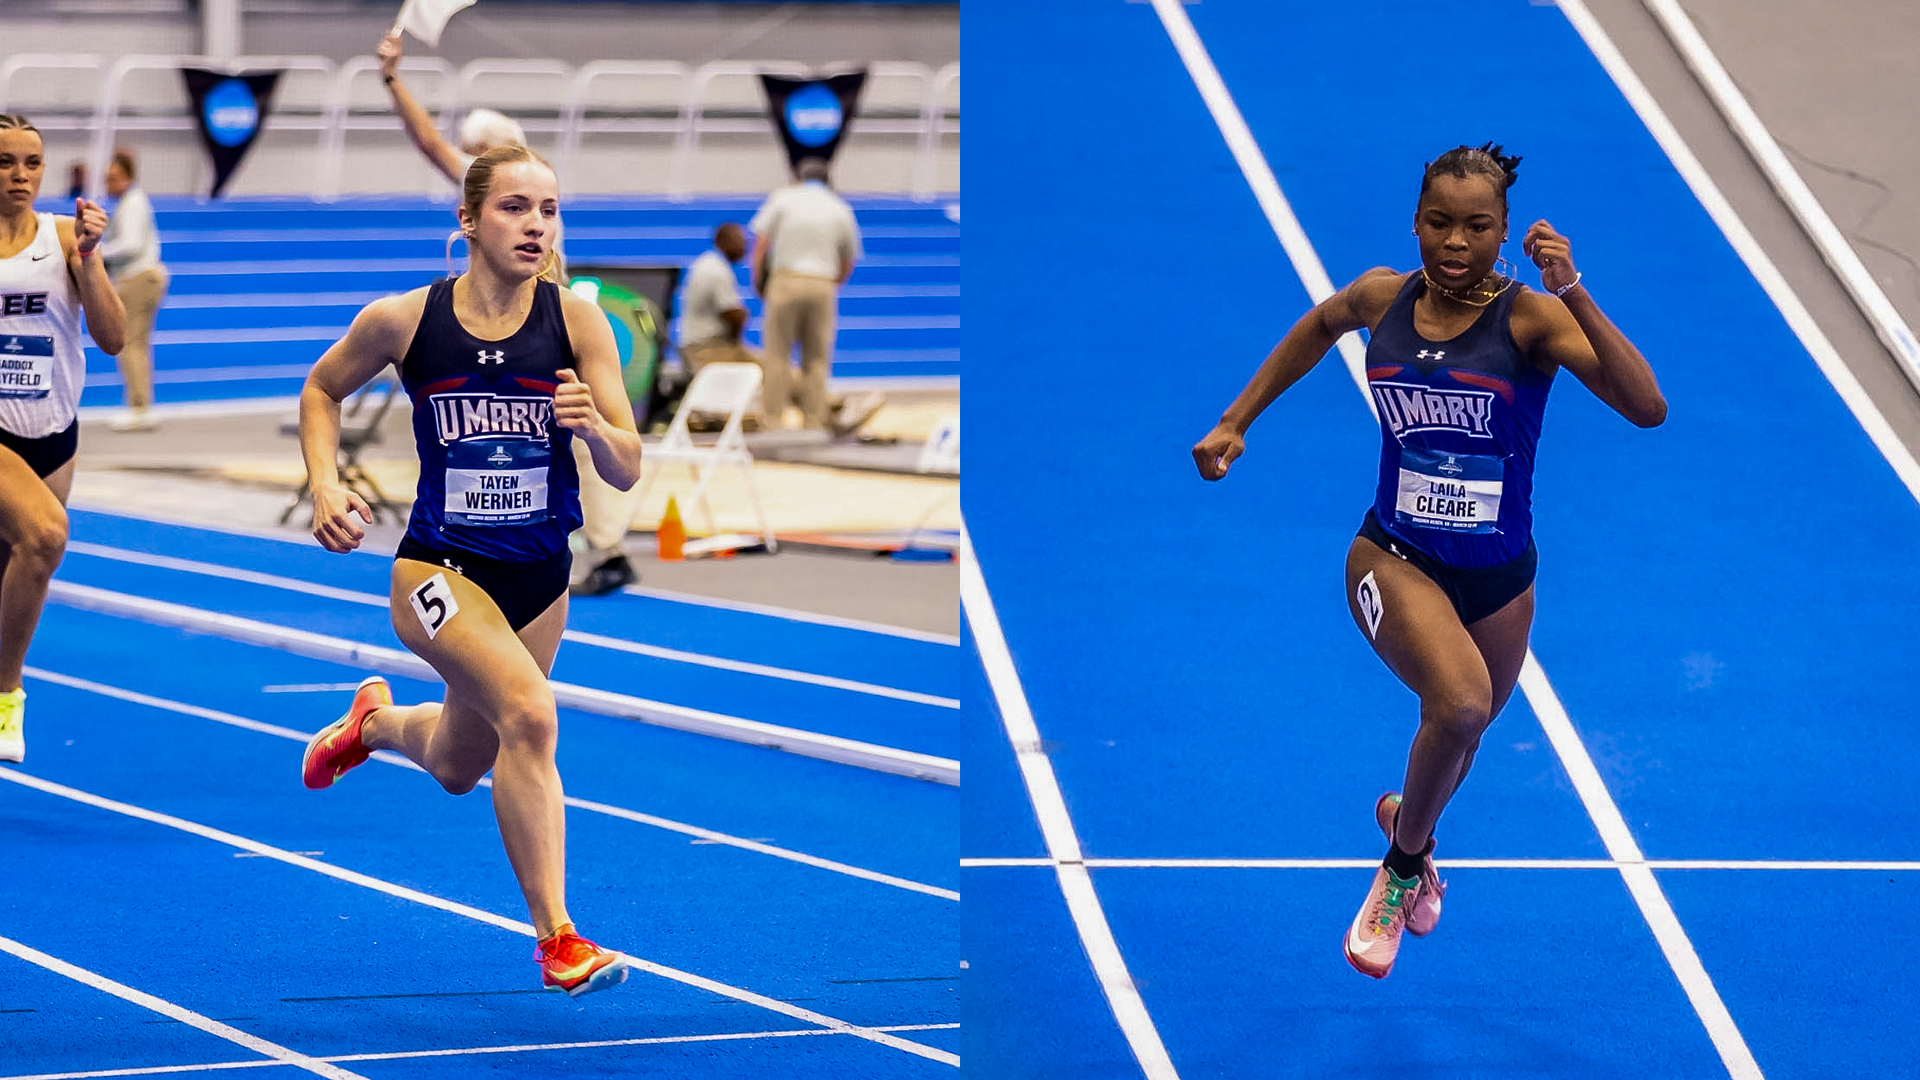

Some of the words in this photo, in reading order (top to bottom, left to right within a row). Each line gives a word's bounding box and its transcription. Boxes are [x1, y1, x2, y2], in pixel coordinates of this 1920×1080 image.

[0, 292, 48, 318] EE
[0, 359, 34, 371] ADDOX
[0, 372, 41, 386] YFIELD
[436, 398, 548, 441] UMARY
[1374, 387, 1486, 433] UMARY
[479, 475, 519, 490] TAYEN
[1429, 481, 1466, 498] LAILA
[465, 490, 532, 510] WERNER
[1416, 495, 1477, 518] CLEARE
[416, 581, 447, 631] 5
[1360, 582, 1379, 629] 2
